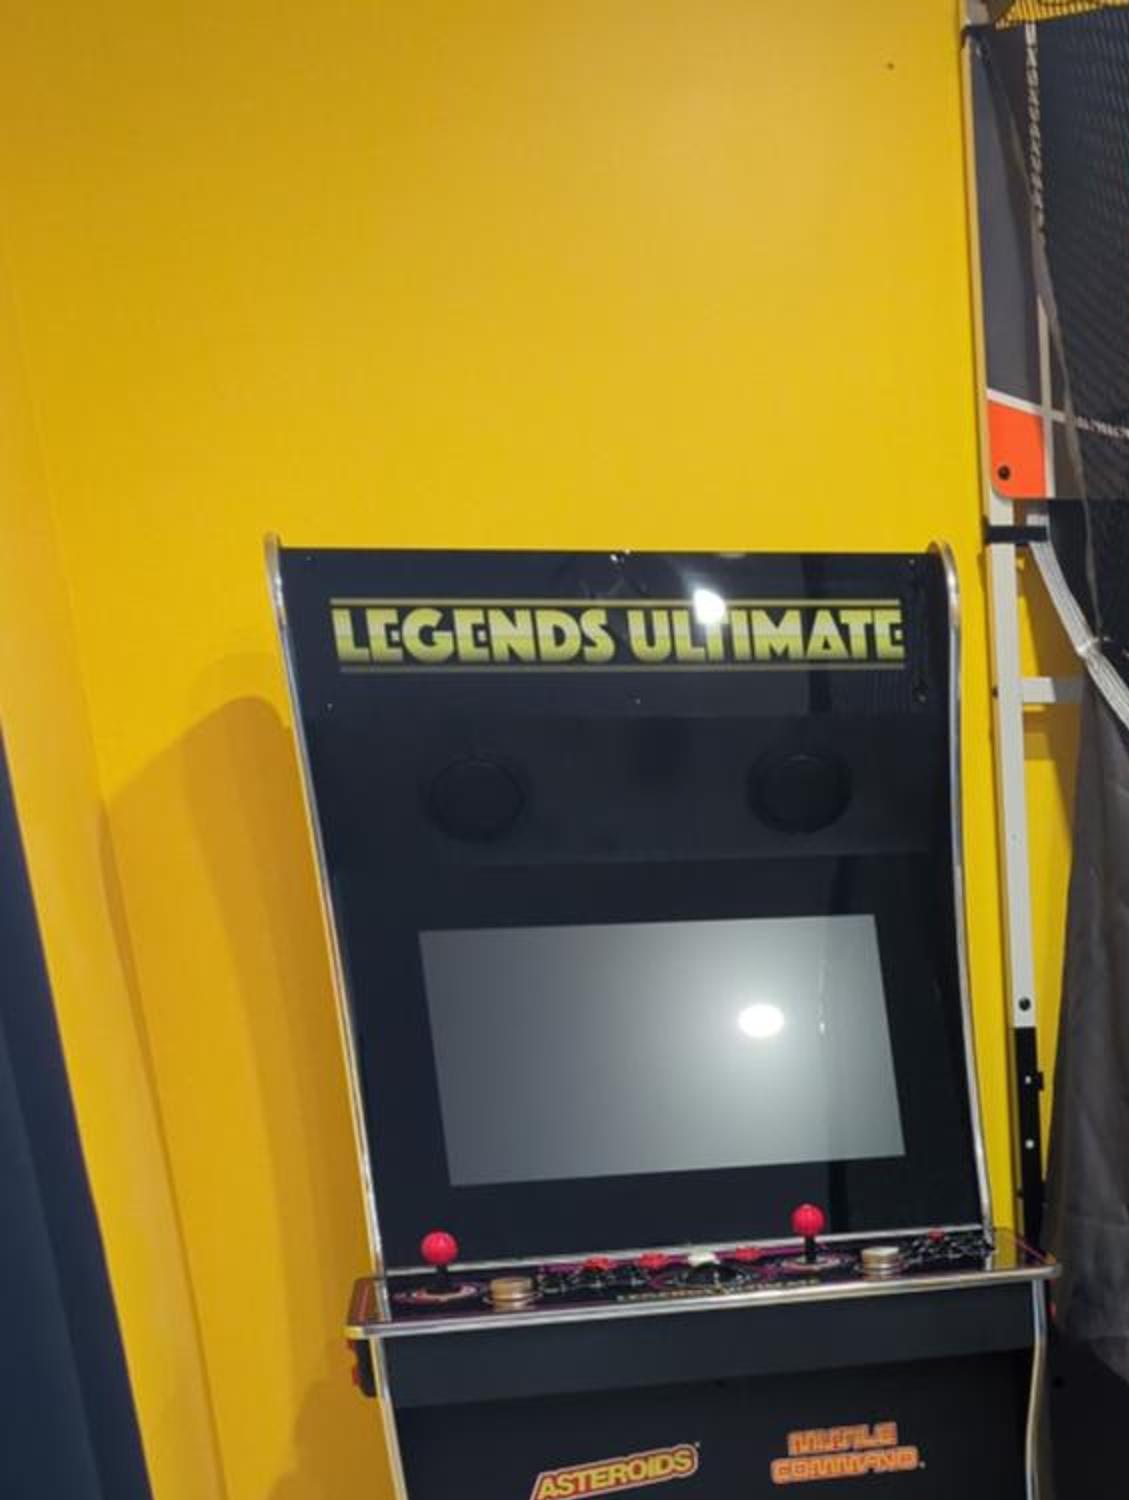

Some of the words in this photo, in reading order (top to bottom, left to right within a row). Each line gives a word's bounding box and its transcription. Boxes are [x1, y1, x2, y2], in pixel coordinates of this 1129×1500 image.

[331, 607, 615, 663] LEGENDS
[627, 608, 905, 663] ULTIMATE
[771, 1445, 919, 1484] COMMAND
